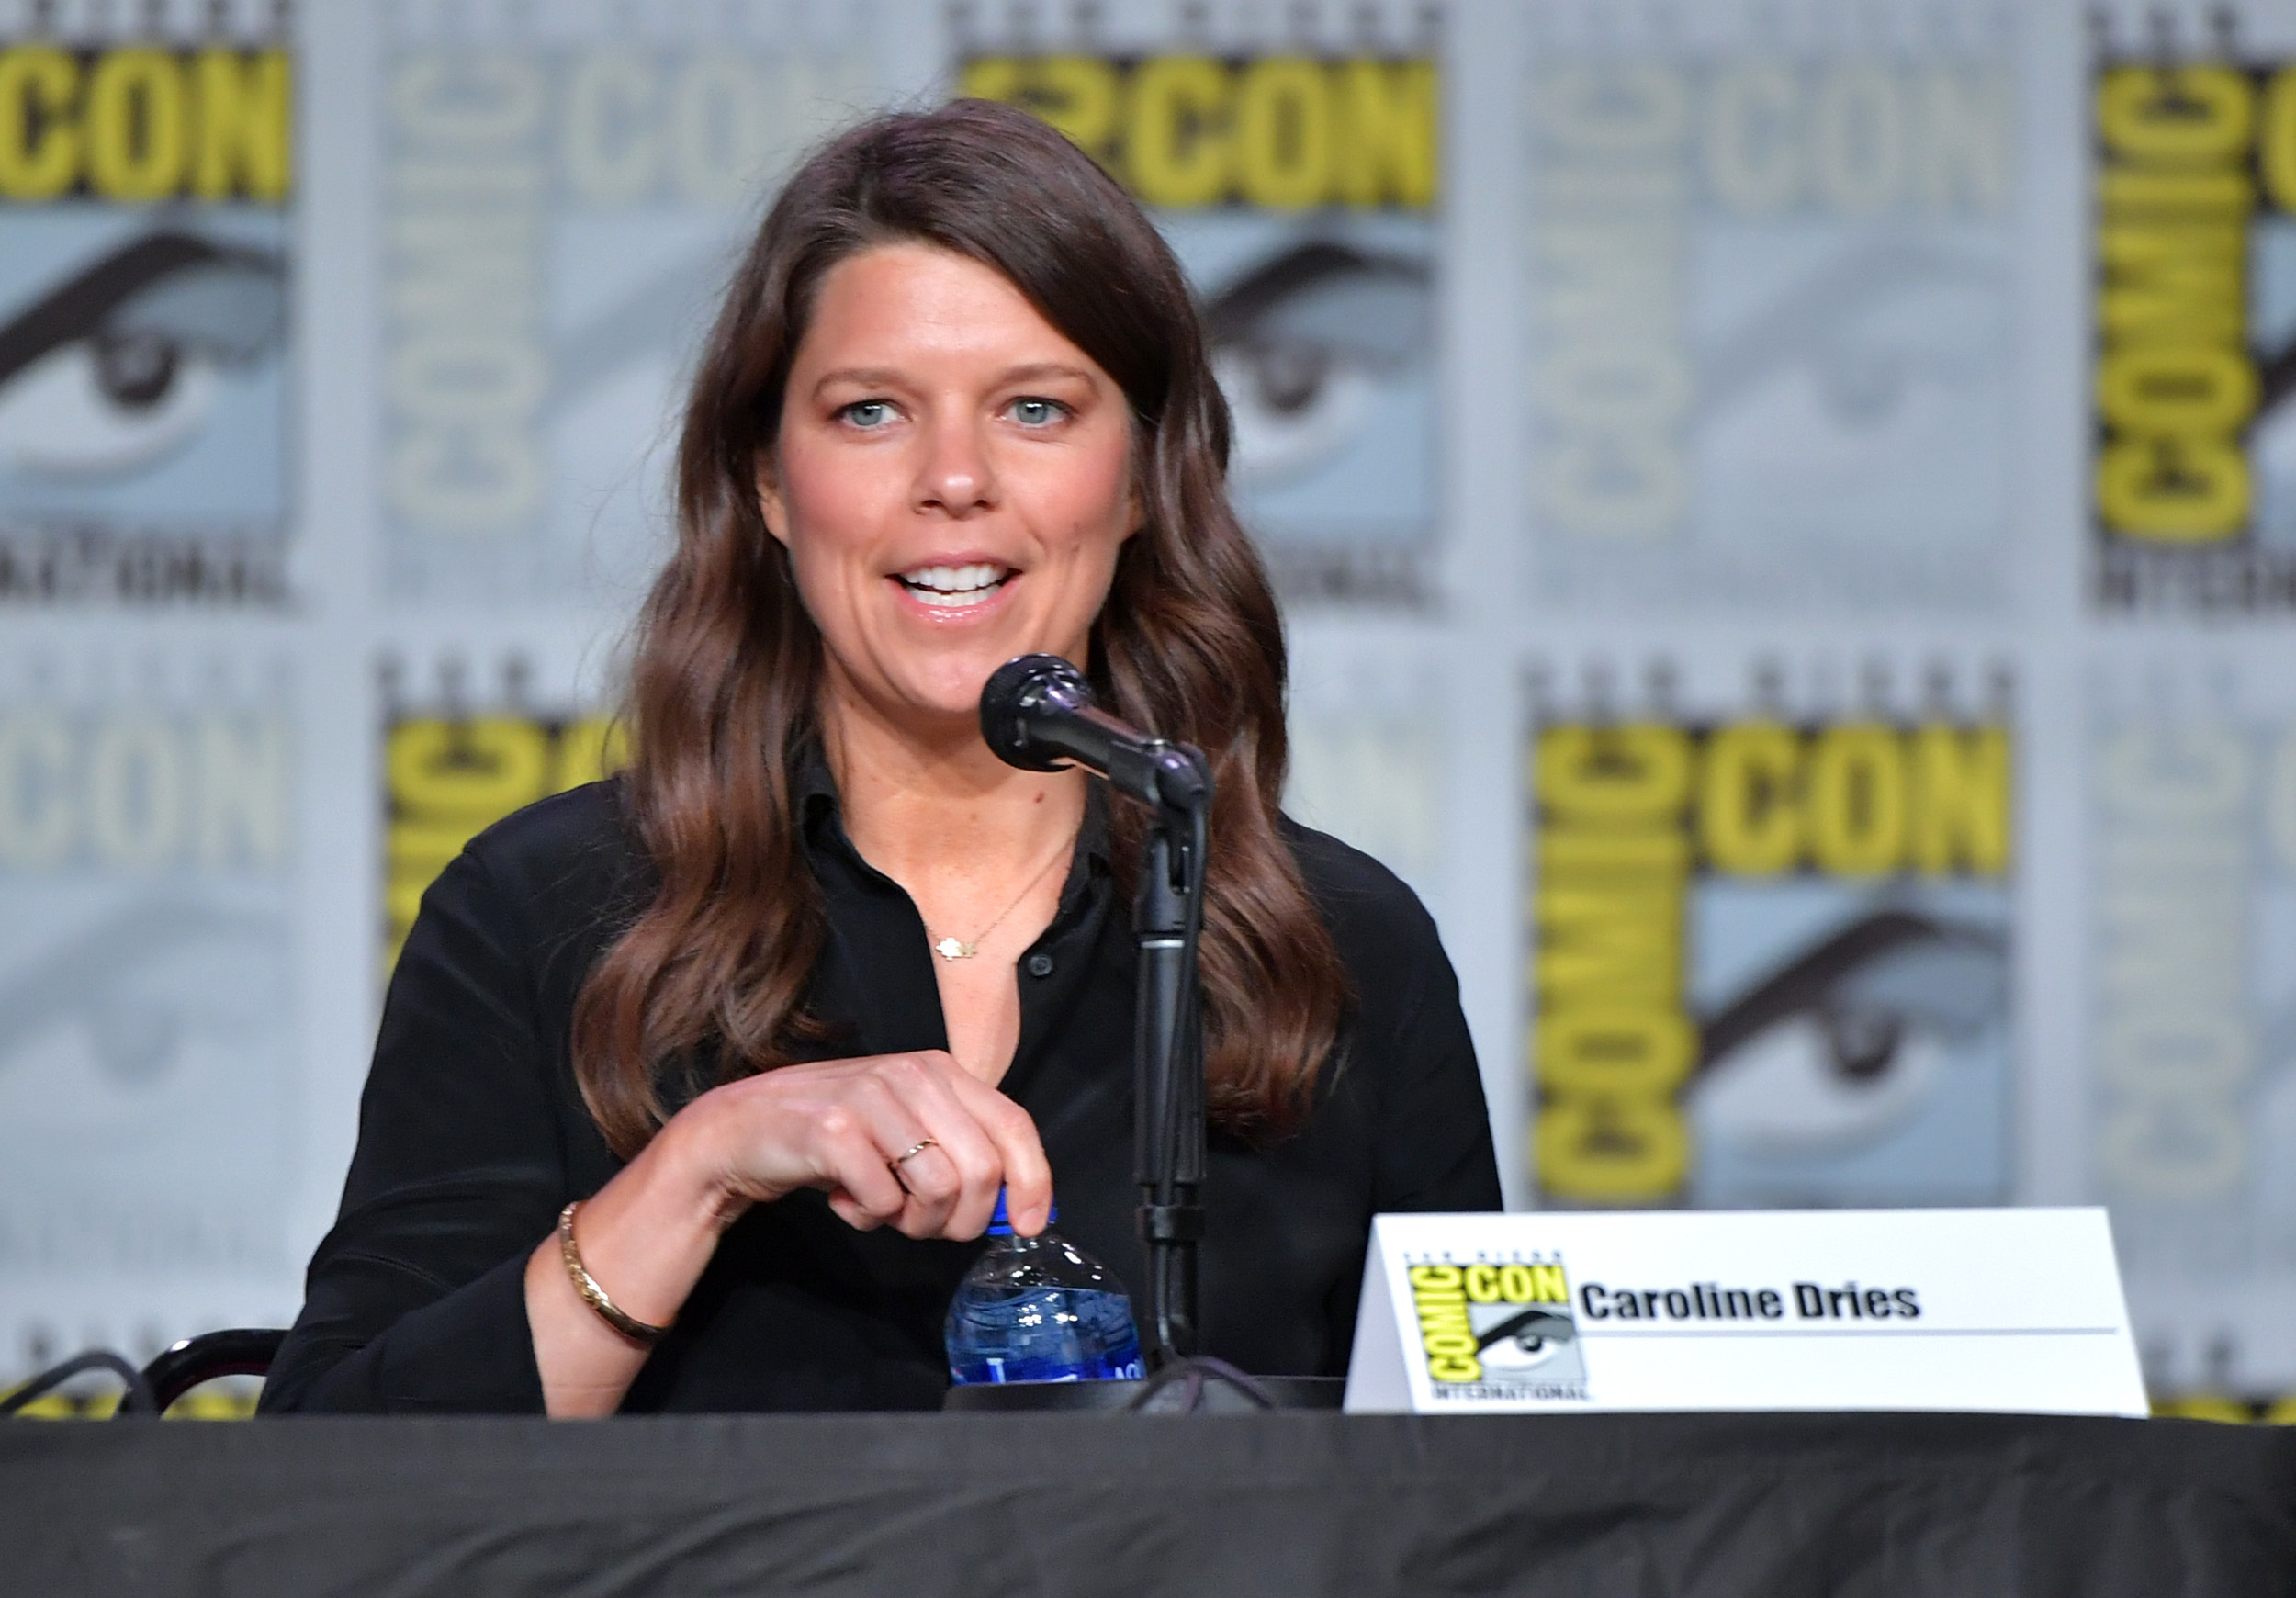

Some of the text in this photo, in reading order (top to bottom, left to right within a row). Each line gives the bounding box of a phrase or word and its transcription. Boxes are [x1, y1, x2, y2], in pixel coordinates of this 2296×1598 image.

[0, 44, 292, 204] CON
[1125, 55, 1437, 211] CON
[1704, 66, 2011, 216] CON
[390, 53, 546, 533] COMIC
[1532, 66, 1697, 540] COMIC
[2096, 64, 2256, 544] COMIC
[1701, 720, 2011, 880] CON
[1530, 720, 1699, 1205] COMIC
[2094, 733, 2252, 1205] COMIC
[1408, 1265, 1481, 1383] COMIC
[1466, 1264, 1569, 1303] CON
[1578, 1280, 1922, 1321] Caroline Dries
